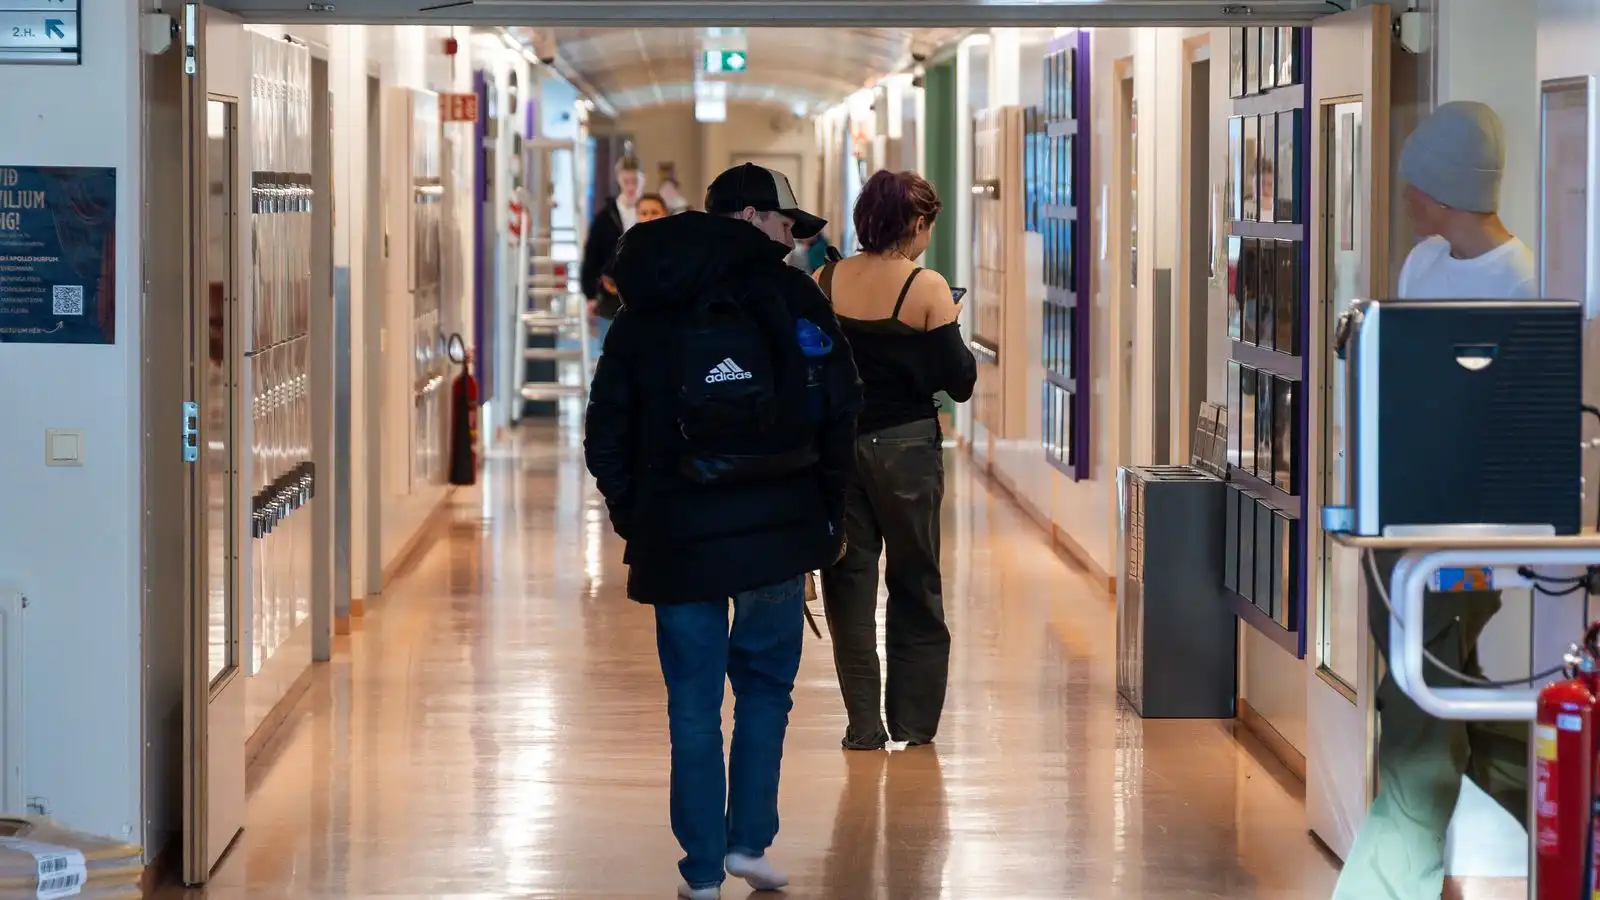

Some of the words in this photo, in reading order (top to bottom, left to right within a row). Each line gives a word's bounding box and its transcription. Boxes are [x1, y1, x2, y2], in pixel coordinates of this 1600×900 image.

[12, 26, 35, 37] 2.H.
[0, 212, 20, 230] IG!
[705, 371, 752, 383] adidas
